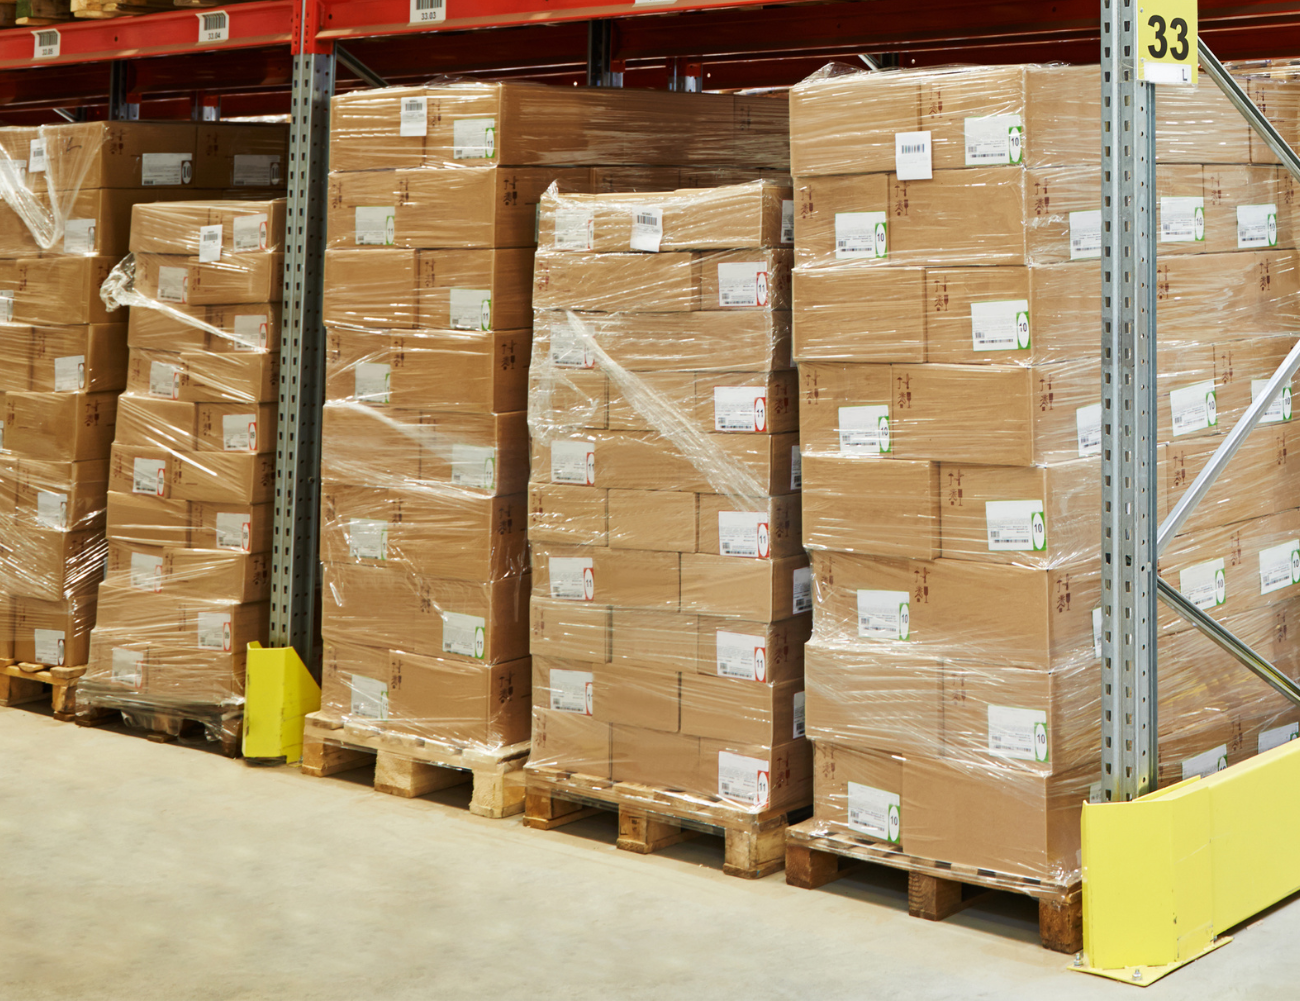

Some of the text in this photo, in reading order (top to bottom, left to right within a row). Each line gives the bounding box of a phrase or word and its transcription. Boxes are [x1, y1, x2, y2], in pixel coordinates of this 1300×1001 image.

[421, 11, 437, 21] 33.03
[1147, 14, 1190, 61] 33
[1181, 68, 1188, 81] L
[486, 139, 493, 149] 11
[1011, 136, 1020, 147] 10
[877, 232, 885, 242] 10
[758, 283, 766, 293] 11
[482, 311, 489, 321] 11
[1018, 322, 1027, 332] 10
[1208, 400, 1215, 410] 10
[756, 408, 764, 418] 11
[880, 426, 889, 436] 10
[1034, 523, 1043, 533] 10
[759, 535, 767, 544] 11
[1293, 558, 1300, 568] 10
[585, 578, 592, 588] 11
[1217, 578, 1224, 588] 10
[901, 613, 909, 624] 10
[476, 640, 484, 649] 11
[757, 658, 764, 669] 11
[1036, 734, 1046, 744] 10
[759, 782, 766, 792] 11
[890, 815, 899, 826] 10
